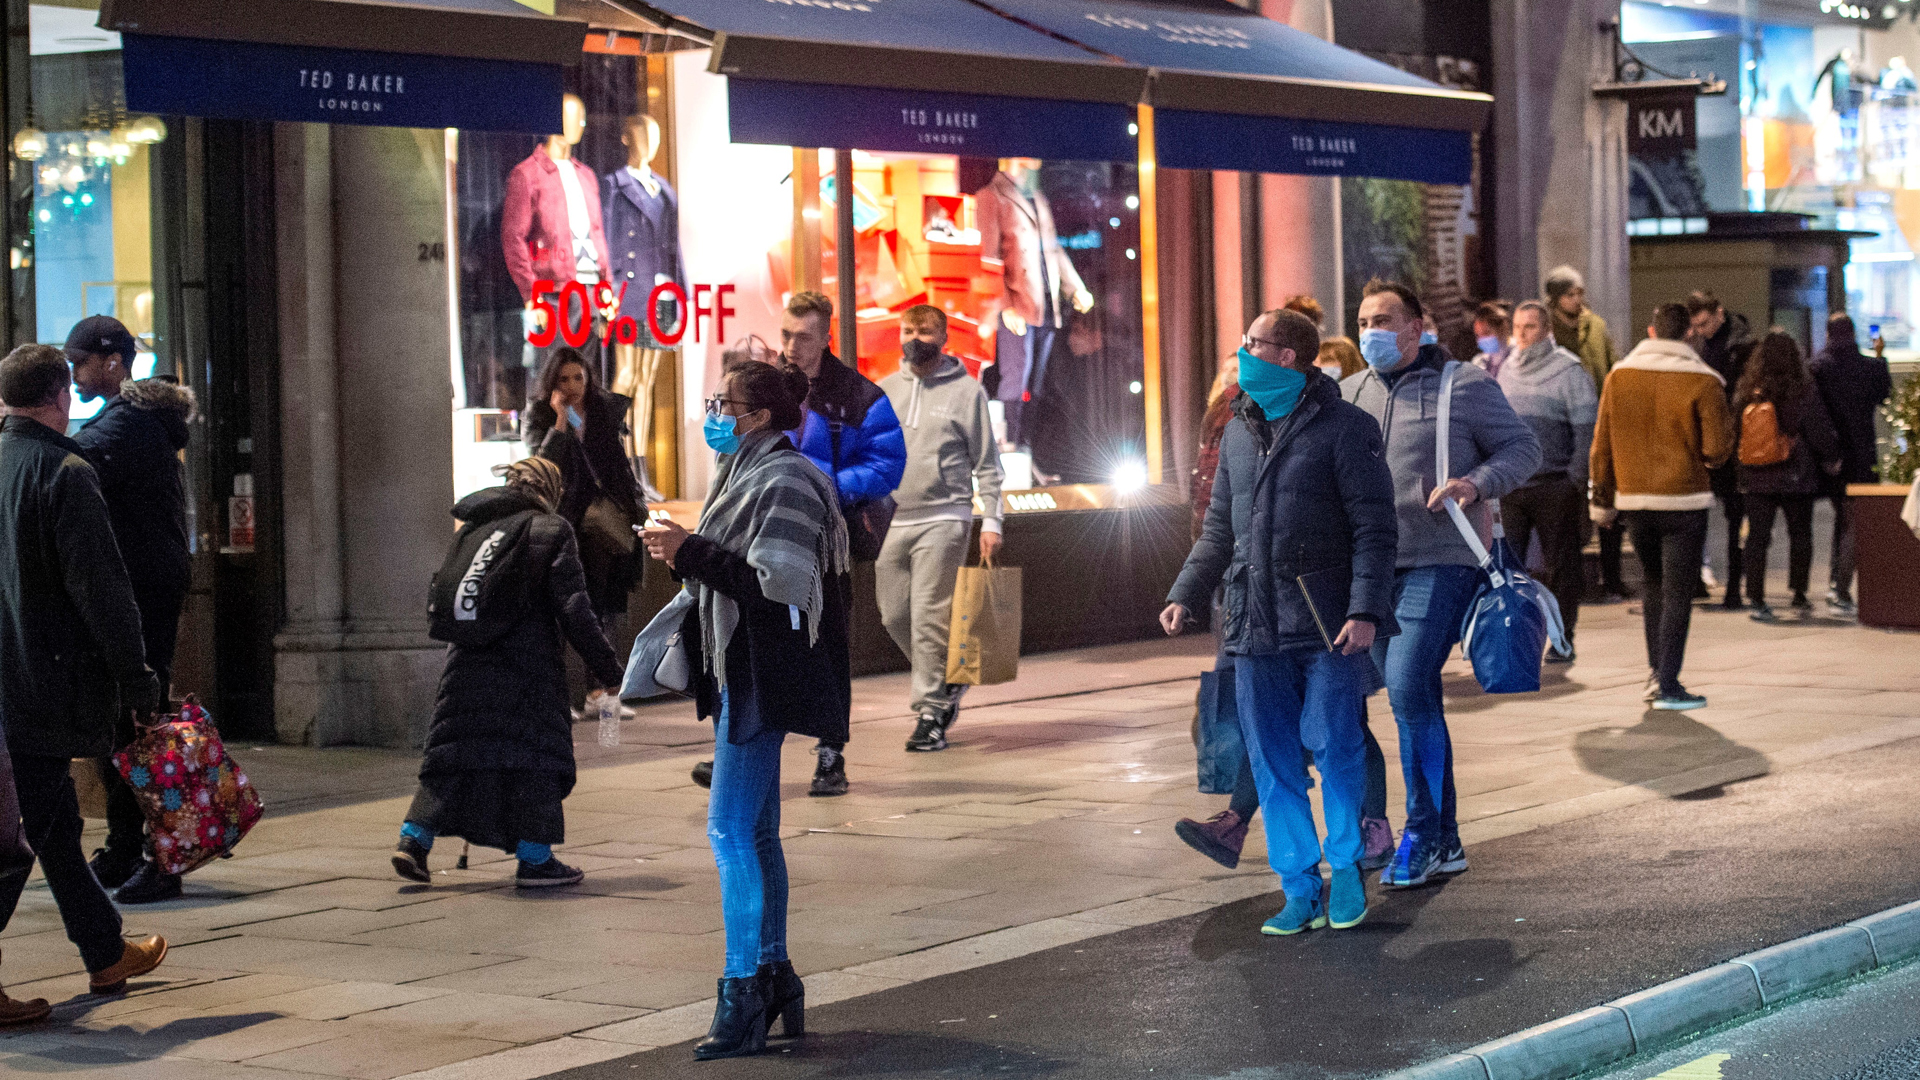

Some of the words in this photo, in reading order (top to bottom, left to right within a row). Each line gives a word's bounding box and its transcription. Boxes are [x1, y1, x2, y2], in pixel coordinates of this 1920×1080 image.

[300, 69, 332, 89] TED
[346, 72, 405, 94] BAKER
[318, 98, 382, 112] LONDON
[901, 108, 926, 127] TED
[935, 110, 978, 129] BAKER
[1639, 109, 1683, 137] KM
[527, 279, 638, 348] 50%
[647, 281, 735, 345] OFF
